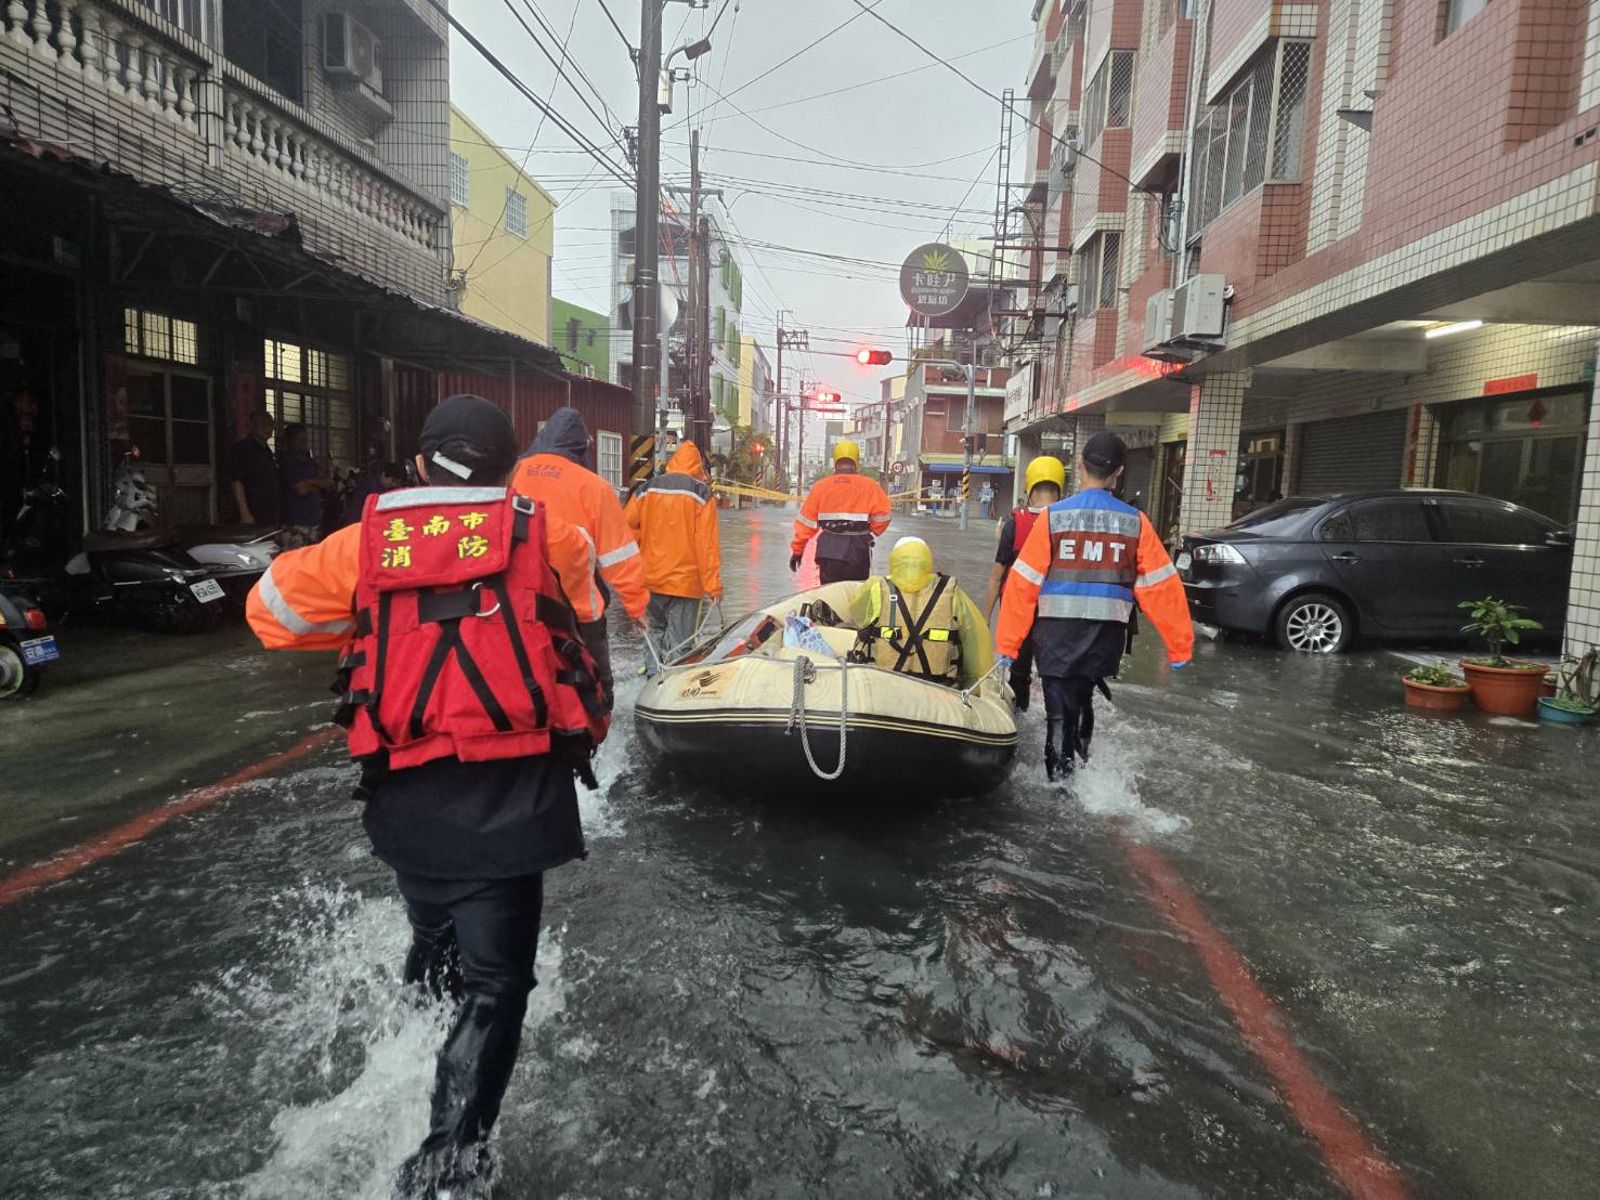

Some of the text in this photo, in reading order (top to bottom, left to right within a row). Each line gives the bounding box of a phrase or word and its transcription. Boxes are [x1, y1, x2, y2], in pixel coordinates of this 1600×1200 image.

[382, 511, 488, 543] 臺南市
[381, 535, 489, 569] 消防
[1059, 539, 1126, 563] EMT
